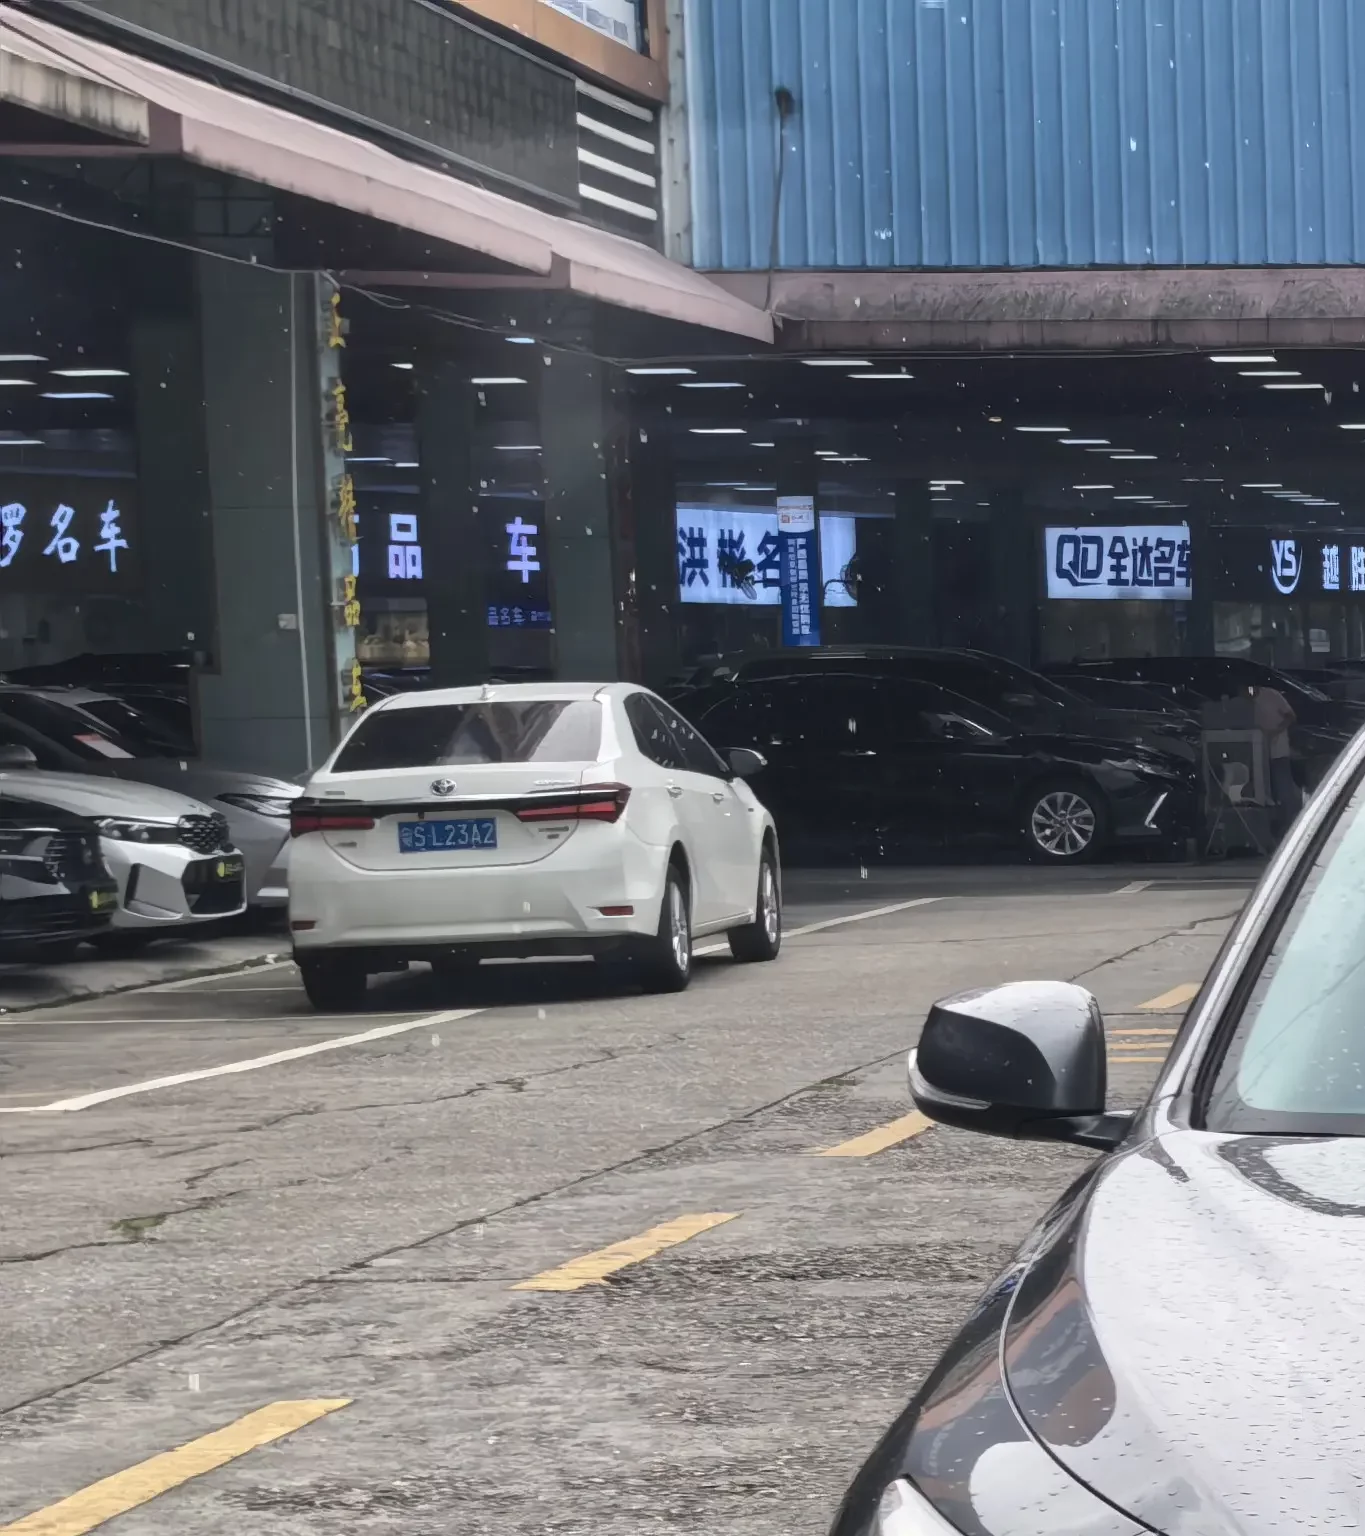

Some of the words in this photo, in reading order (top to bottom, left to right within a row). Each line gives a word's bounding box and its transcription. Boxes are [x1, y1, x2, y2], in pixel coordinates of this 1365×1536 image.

[1107, 536, 1190, 587] 全达名车
[1271, 540, 1297, 576] YS
